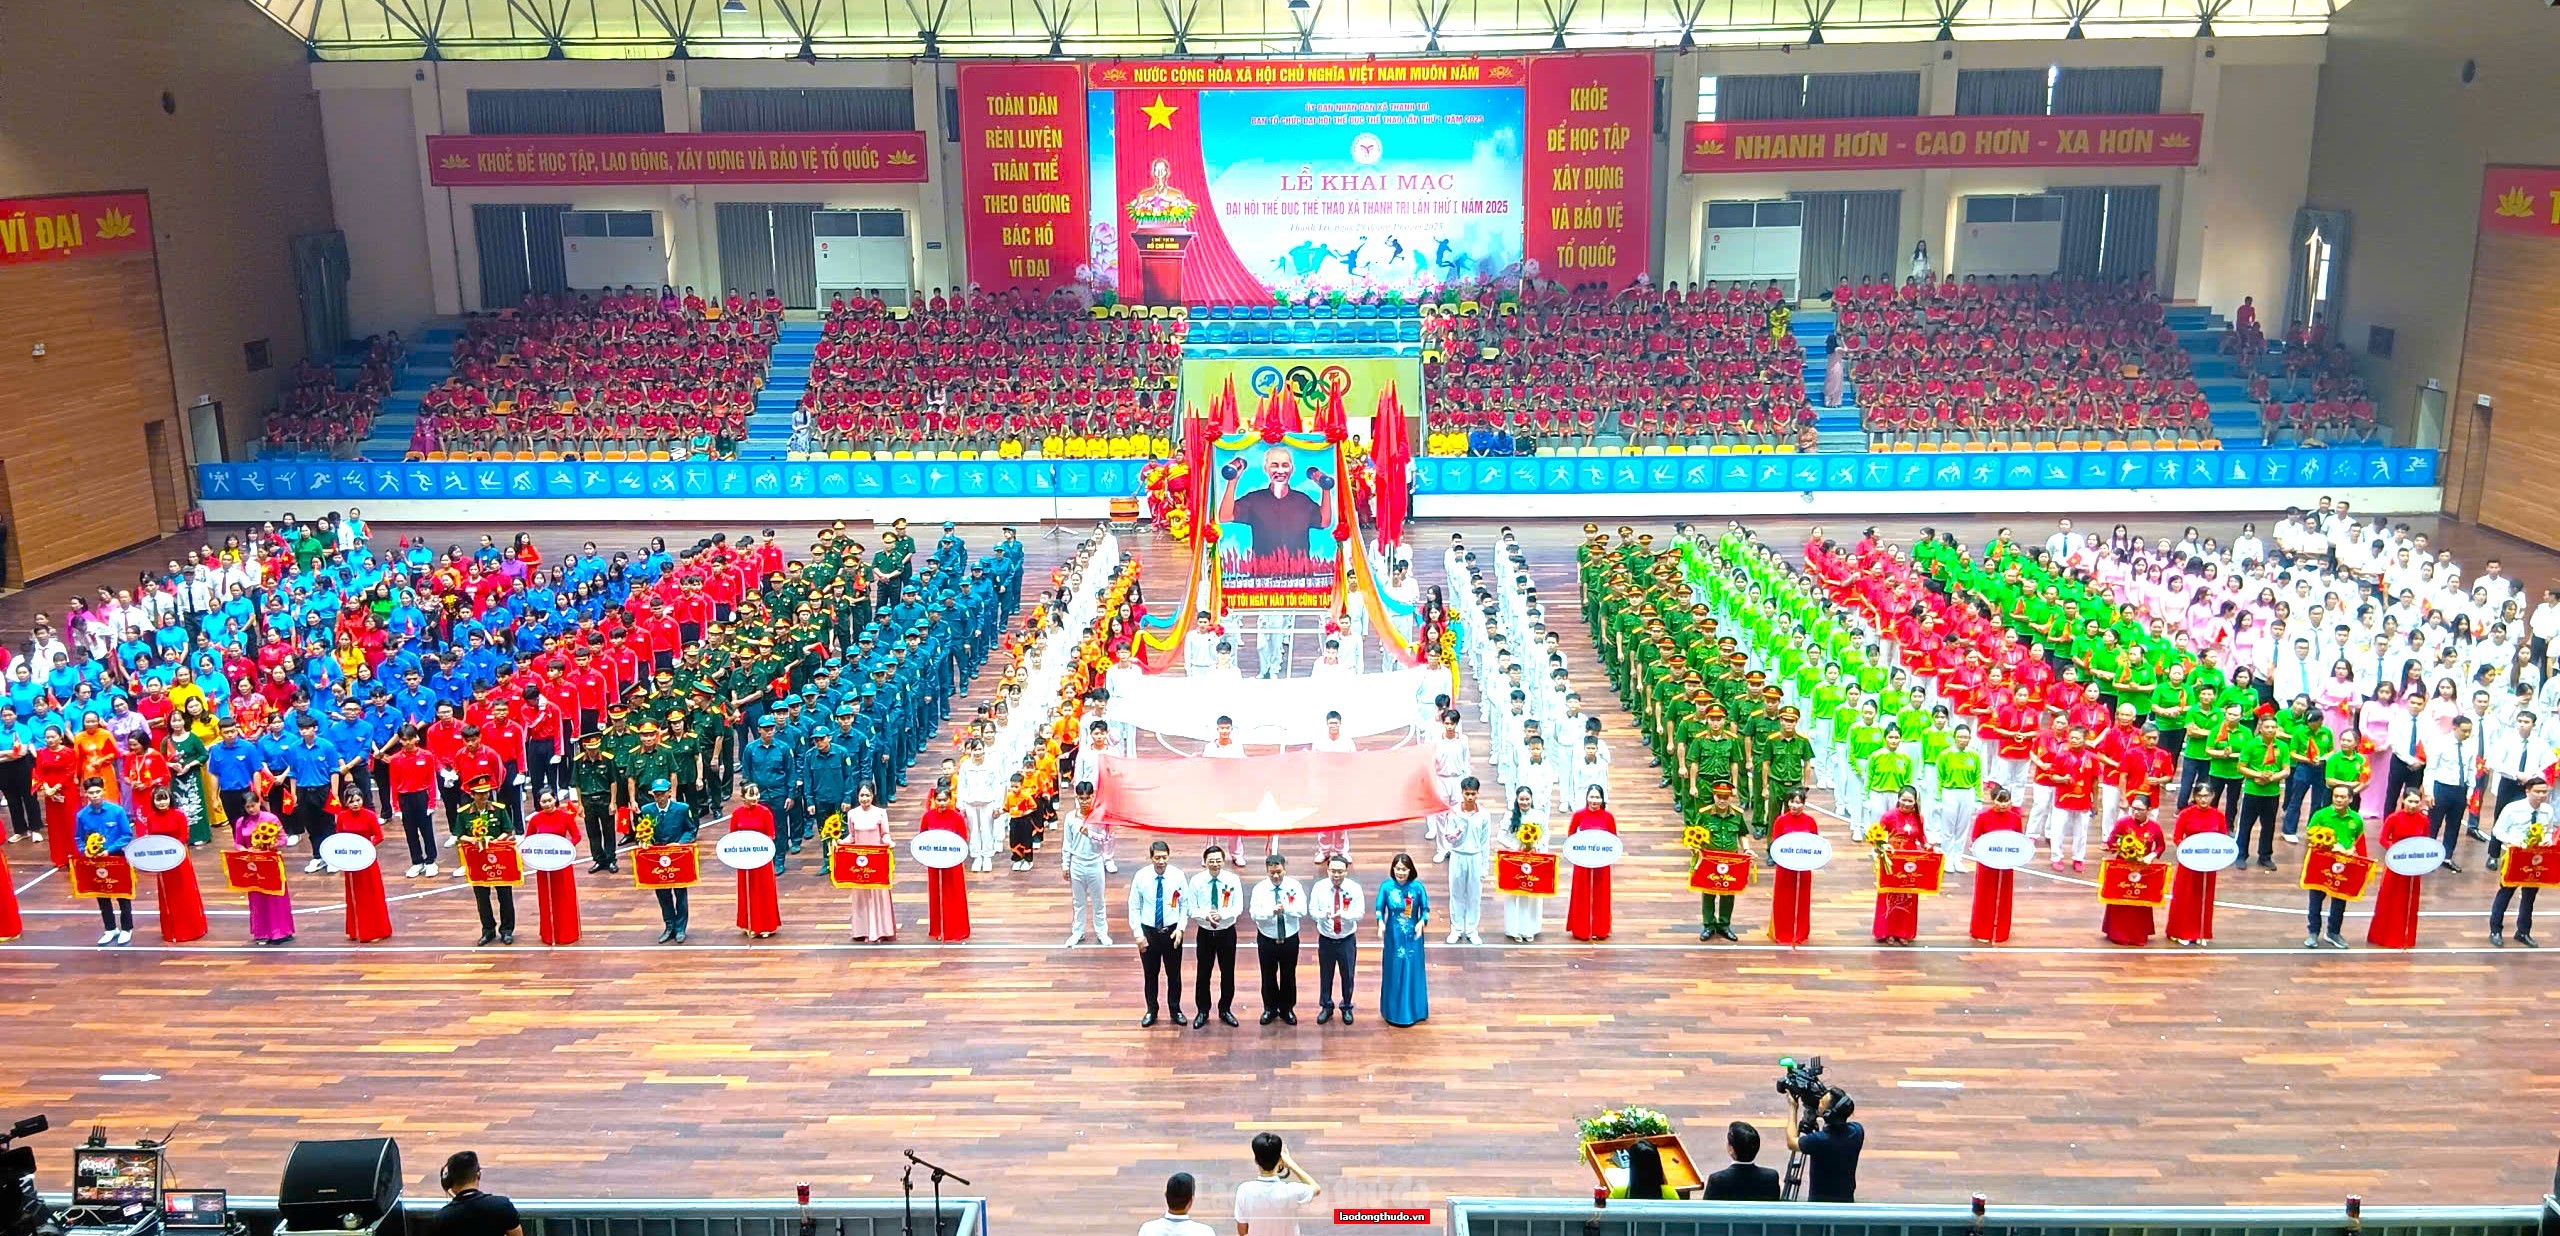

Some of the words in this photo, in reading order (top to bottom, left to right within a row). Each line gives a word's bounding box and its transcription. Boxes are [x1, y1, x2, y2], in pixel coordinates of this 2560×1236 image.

[1134, 65, 1167, 82] NƯỚC
[1171, 66, 1204, 85] CỘNG
[1208, 65, 1232, 82] HÒA
[1236, 65, 1253, 82] XÃ
[1255, 65, 1276, 84] HỘI
[1280, 64, 1304, 82] CHỦ
[1307, 65, 1345, 82] NGHĨA
[1349, 64, 1374, 84] VIỆT
[1377, 67, 1406, 81] NAM
[1410, 65, 1447, 81] MUÔN
[1450, 64, 1479, 81] NĂM
[987, 92, 1024, 116] TOÀN
[1028, 92, 1058, 116] DÂN
[1570, 80, 1608, 111] KHỎE
[985, 126, 1014, 148] RÈN
[1018, 125, 1062, 152] LUYỆN
[1547, 119, 1567, 152] ĐỂ
[1570, 127, 1599, 156] HỌC
[1603, 122, 1630, 155] TẬP
[1735, 134, 1826, 160] NHANH
[1833, 130, 1888, 158] HƠN
[1915, 131, 1967, 156] CAO
[1975, 127, 2030, 155] HƠN
[2056, 129, 2089, 154] XA
[2098, 127, 2153, 154] HƠN
[477, 147, 514, 172] KHOẺ
[516, 146, 538, 172] ĐỂ
[538, 151, 567, 176] HỌC
[569, 148, 599, 176] TẬP,
[601, 151, 627, 172] LAO
[631, 147, 673, 175] ĐỘNG,
[676, 146, 703, 171] XÂY
[707, 148, 746, 174] DỰNG
[748, 146, 769, 170] VÀ
[769, 144, 798, 170] BẢO
[801, 146, 819, 174] VỆ
[822, 142, 839, 170] TỔ
[842, 143, 879, 171] QUỐC
[992, 158, 1029, 181] THÂN
[1033, 154, 1059, 181] THỂ
[1280, 166, 1313, 191] LỄ
[1321, 175, 1387, 191] KHAI
[1397, 174, 1454, 195] MẠC
[1552, 163, 1581, 191] XÂY
[1584, 164, 1624, 195] DỰNG
[983, 194, 1018, 214] THEO
[1022, 192, 1070, 214] GƯƠNG
[1322, 201, 1344, 215] THAO
[1363, 201, 1393, 215] THANH
[1485, 200, 1508, 214] 2025
[1551, 202, 1570, 230] VÀ
[1574, 199, 1602, 230] BẢO
[1607, 201, 1624, 233] VỆ
[0, 211, 30, 254] VĨ
[35, 213, 83, 255] ĐẠI
[1003, 223, 1030, 246] BÁC
[1034, 221, 1054, 245] HỒ
[1557, 237, 1576, 269] TỔ
[1578, 237, 1616, 270] QUỐC
[1009, 256, 1023, 277] VĨ
[1026, 257, 1050, 281] ĐẠI
[1237, 593, 1248, 607] TÔI
[1250, 592, 1268, 606] NGÀY
[1270, 592, 1284, 606] NÀO
[1286, 592, 1297, 606] TÔI
[1298, 592, 1317, 606] CŨNG
